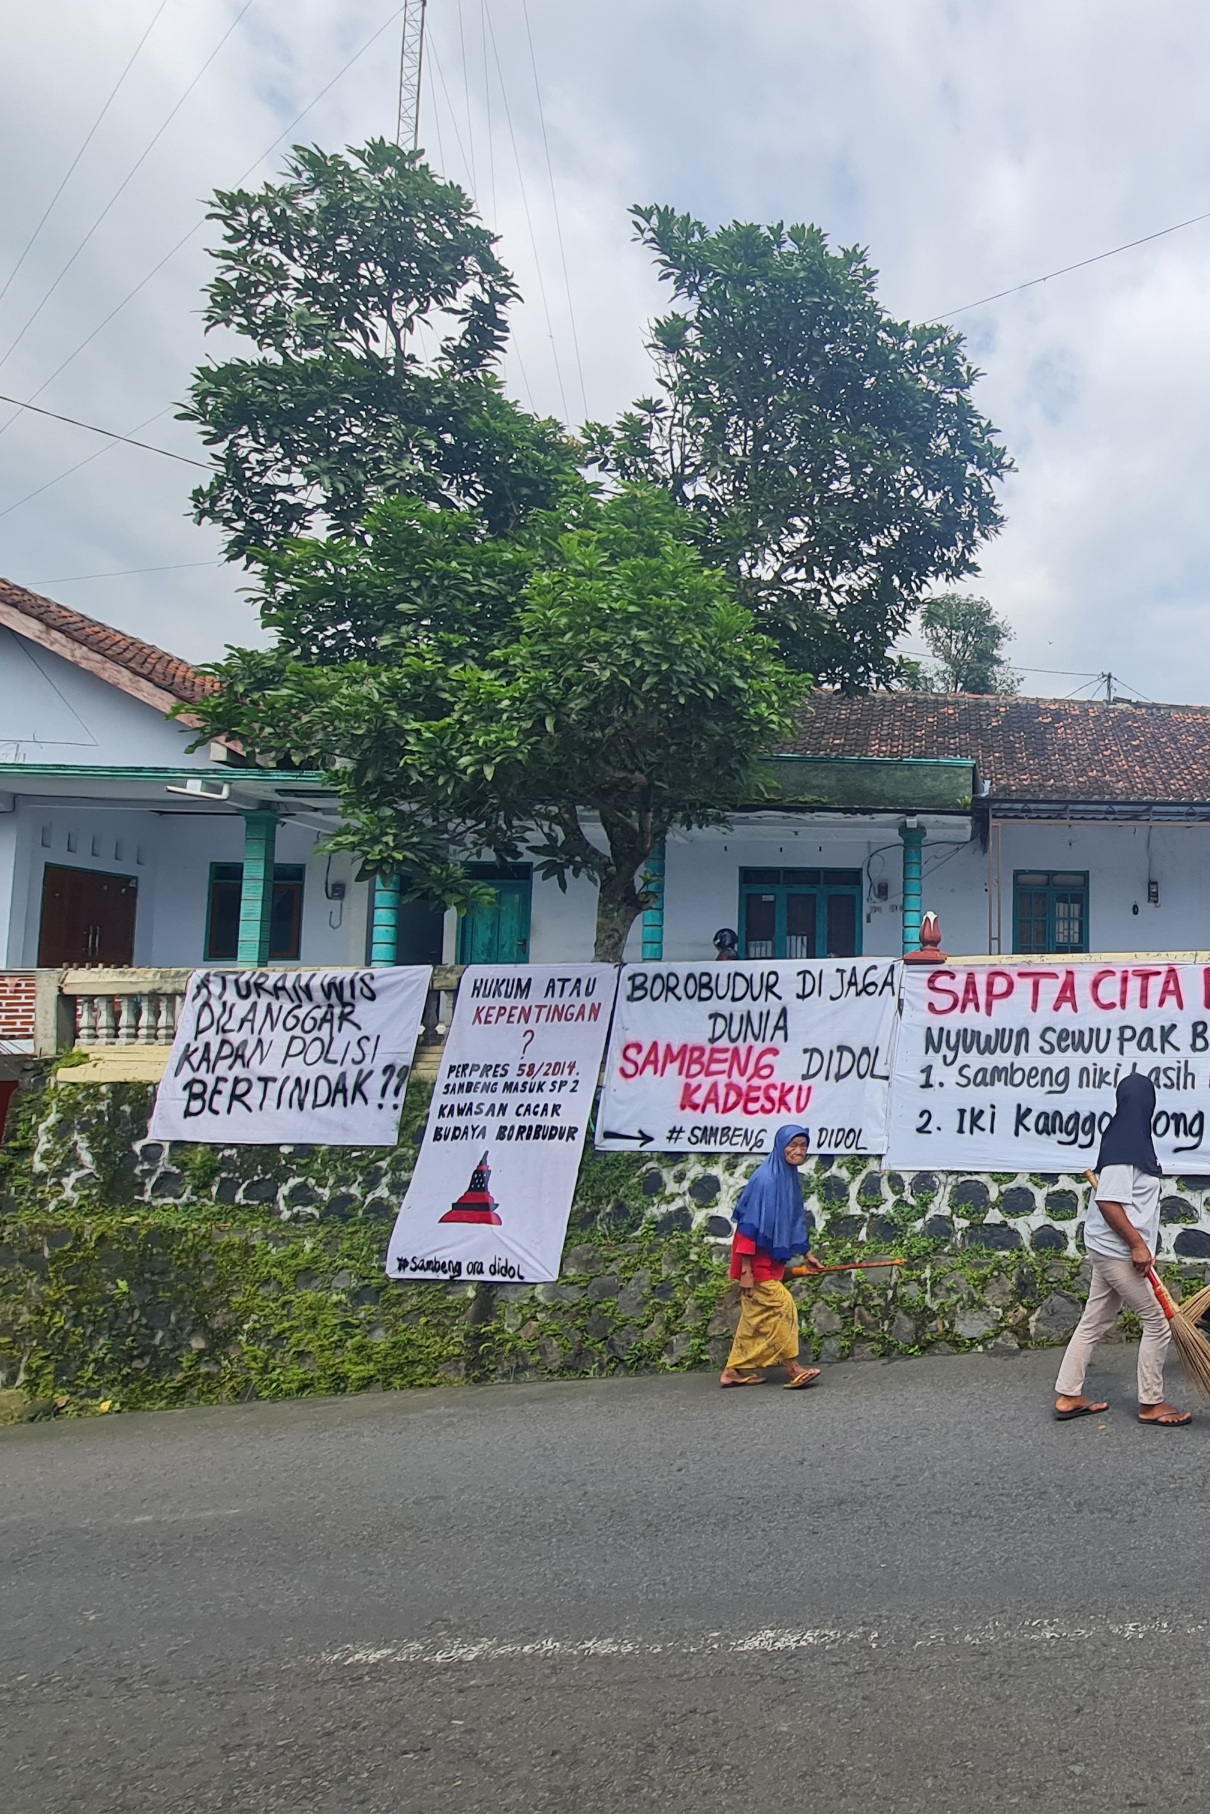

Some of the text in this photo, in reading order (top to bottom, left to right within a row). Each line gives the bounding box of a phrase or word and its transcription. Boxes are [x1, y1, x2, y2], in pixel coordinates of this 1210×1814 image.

[193, 971, 377, 1003] ATURAN WIS
[471, 977, 597, 999] HUKUM ATAU
[626, 963, 896, 1003] BOROBUDUR DI JAGA
[927, 969, 1077, 1017] SAPTA
[1091, 966, 1184, 1011] CITA
[194, 1000, 362, 1041] DILANGGAR
[472, 1002, 601, 1025] KEPENTINGAN
[708, 1007, 789, 1045] DUNIA
[174, 1034, 380, 1077] KAPAN POLISI
[520, 1029, 534, 1060] ?
[447, 1063, 510, 1079] PERPRES
[618, 1041, 890, 1082] SAMBENG DIDOL
[442, 1081, 498, 1095] SAMBENG
[502, 1080, 546, 1094] MASUK
[919, 1064, 945, 1089] 1.
[955, 1062, 1070, 1095] Sambeng
[1078, 1062, 1123, 1089] niki
[438, 1102, 508, 1119] KAWASAN
[679, 1081, 813, 1116] KADESKU
[433, 1124, 579, 1142] BUDAYA BOROBUDUR
[915, 1109, 942, 1135] 2.
[816, 1128, 868, 1151] DIDOL
[467, 1260, 484, 1275] ora
